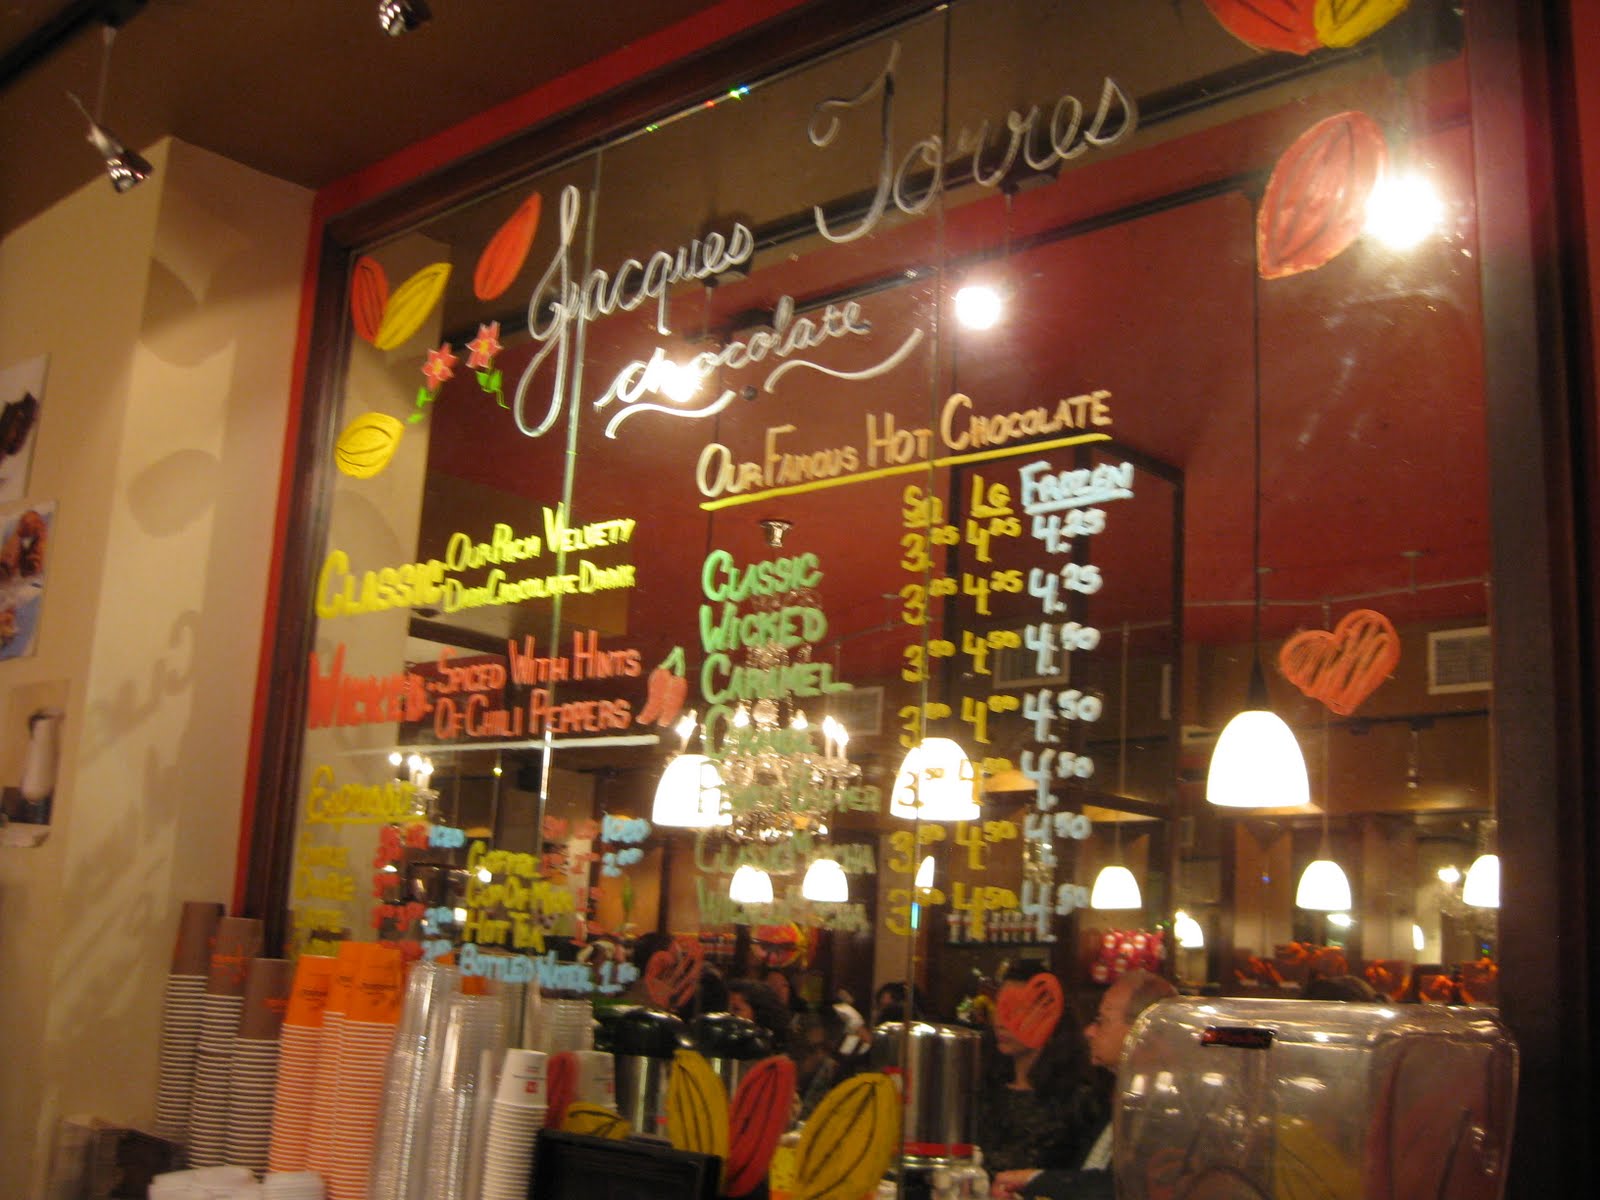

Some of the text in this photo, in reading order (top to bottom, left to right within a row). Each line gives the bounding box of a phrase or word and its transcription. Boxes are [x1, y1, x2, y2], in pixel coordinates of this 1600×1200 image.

[513, 184, 754, 438] Jacques
[763, 424, 860, 488] FAMOUS
[866, 411, 935, 468] HOT
[939, 389, 1114, 451] CHOCOLATE
[1020, 461, 1135, 513] FROZEN
[542, 501, 637, 554] VELVETY
[701, 549, 825, 603] CLASSIC
[698, 601, 829, 654] WICKED
[528, 687, 633, 735] PEPPERS
